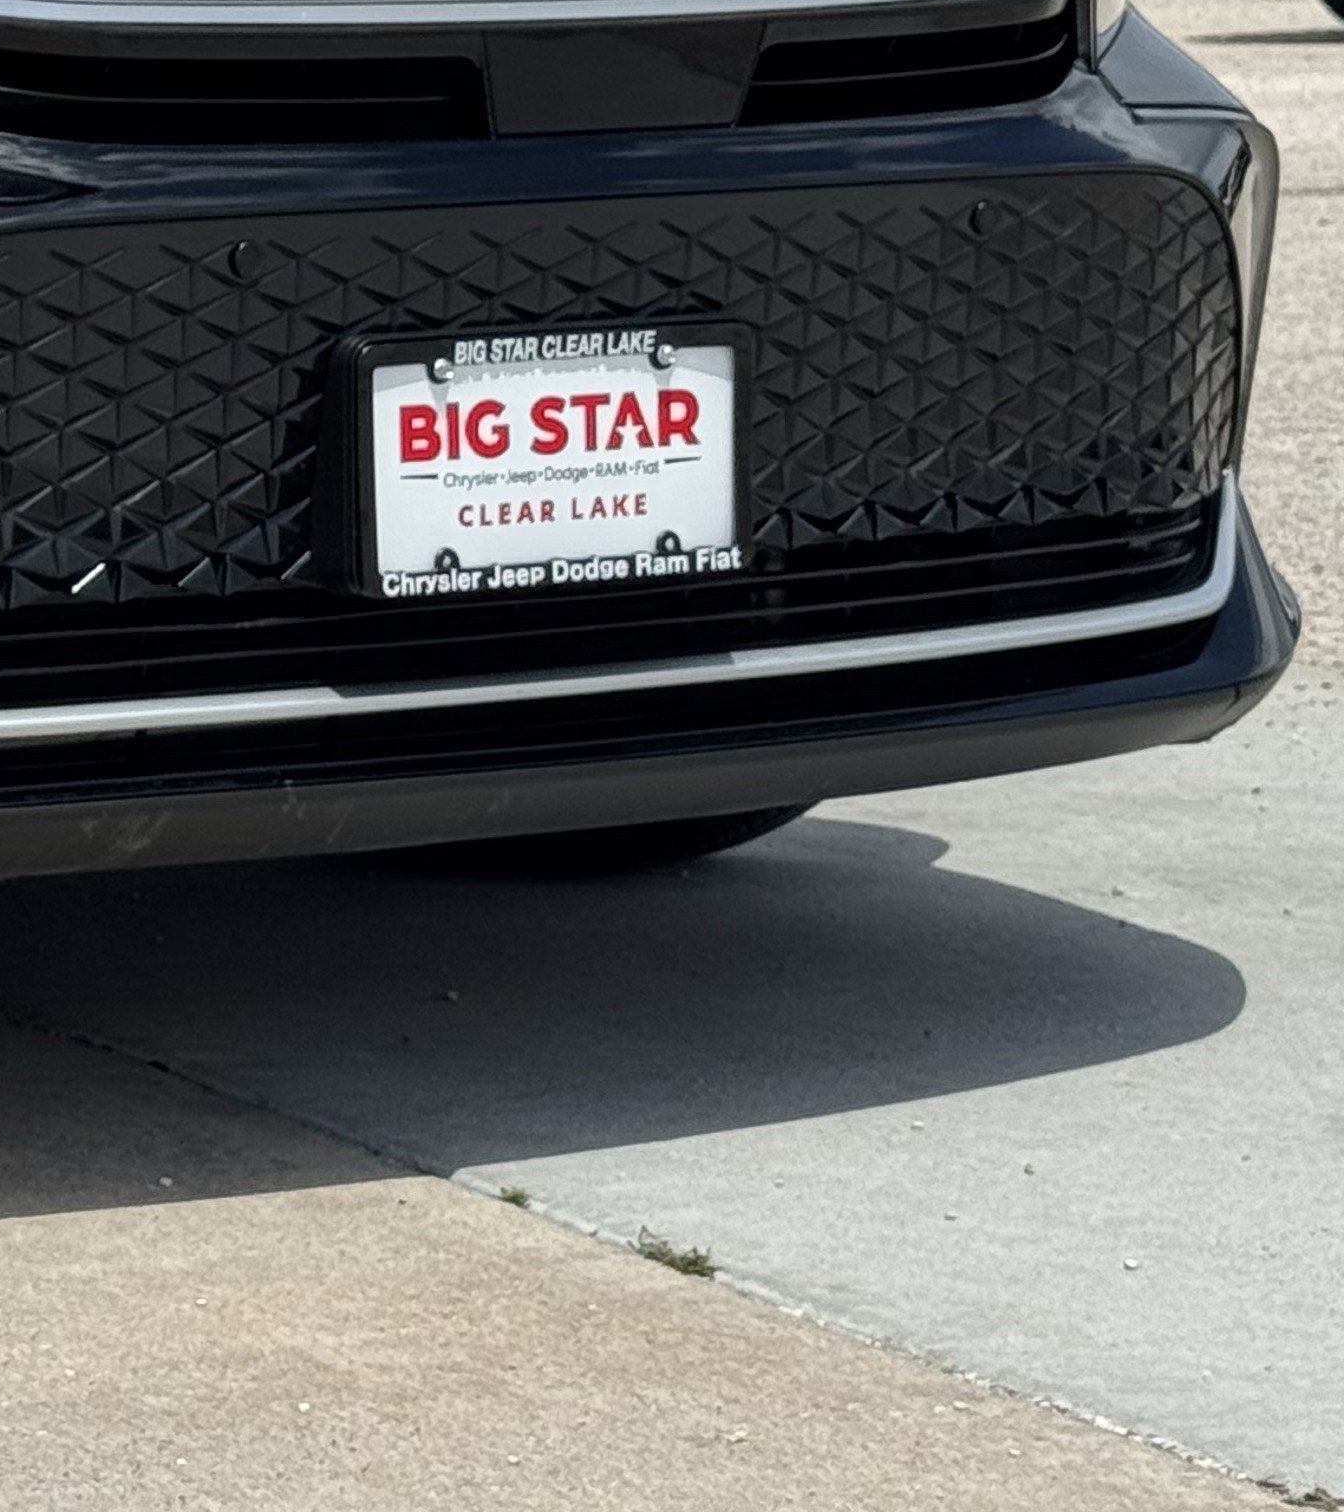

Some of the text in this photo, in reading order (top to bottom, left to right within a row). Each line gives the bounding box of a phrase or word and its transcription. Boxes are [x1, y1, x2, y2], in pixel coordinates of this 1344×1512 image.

[454, 330, 657, 365] BIG STAR CLEAR LAKE
[399, 390, 701, 463] BIG STAR
[458, 493, 648, 527] CLEAR LAKE
[382, 545, 743, 597] Chrysler Jeep Dodge Ram Fiat
